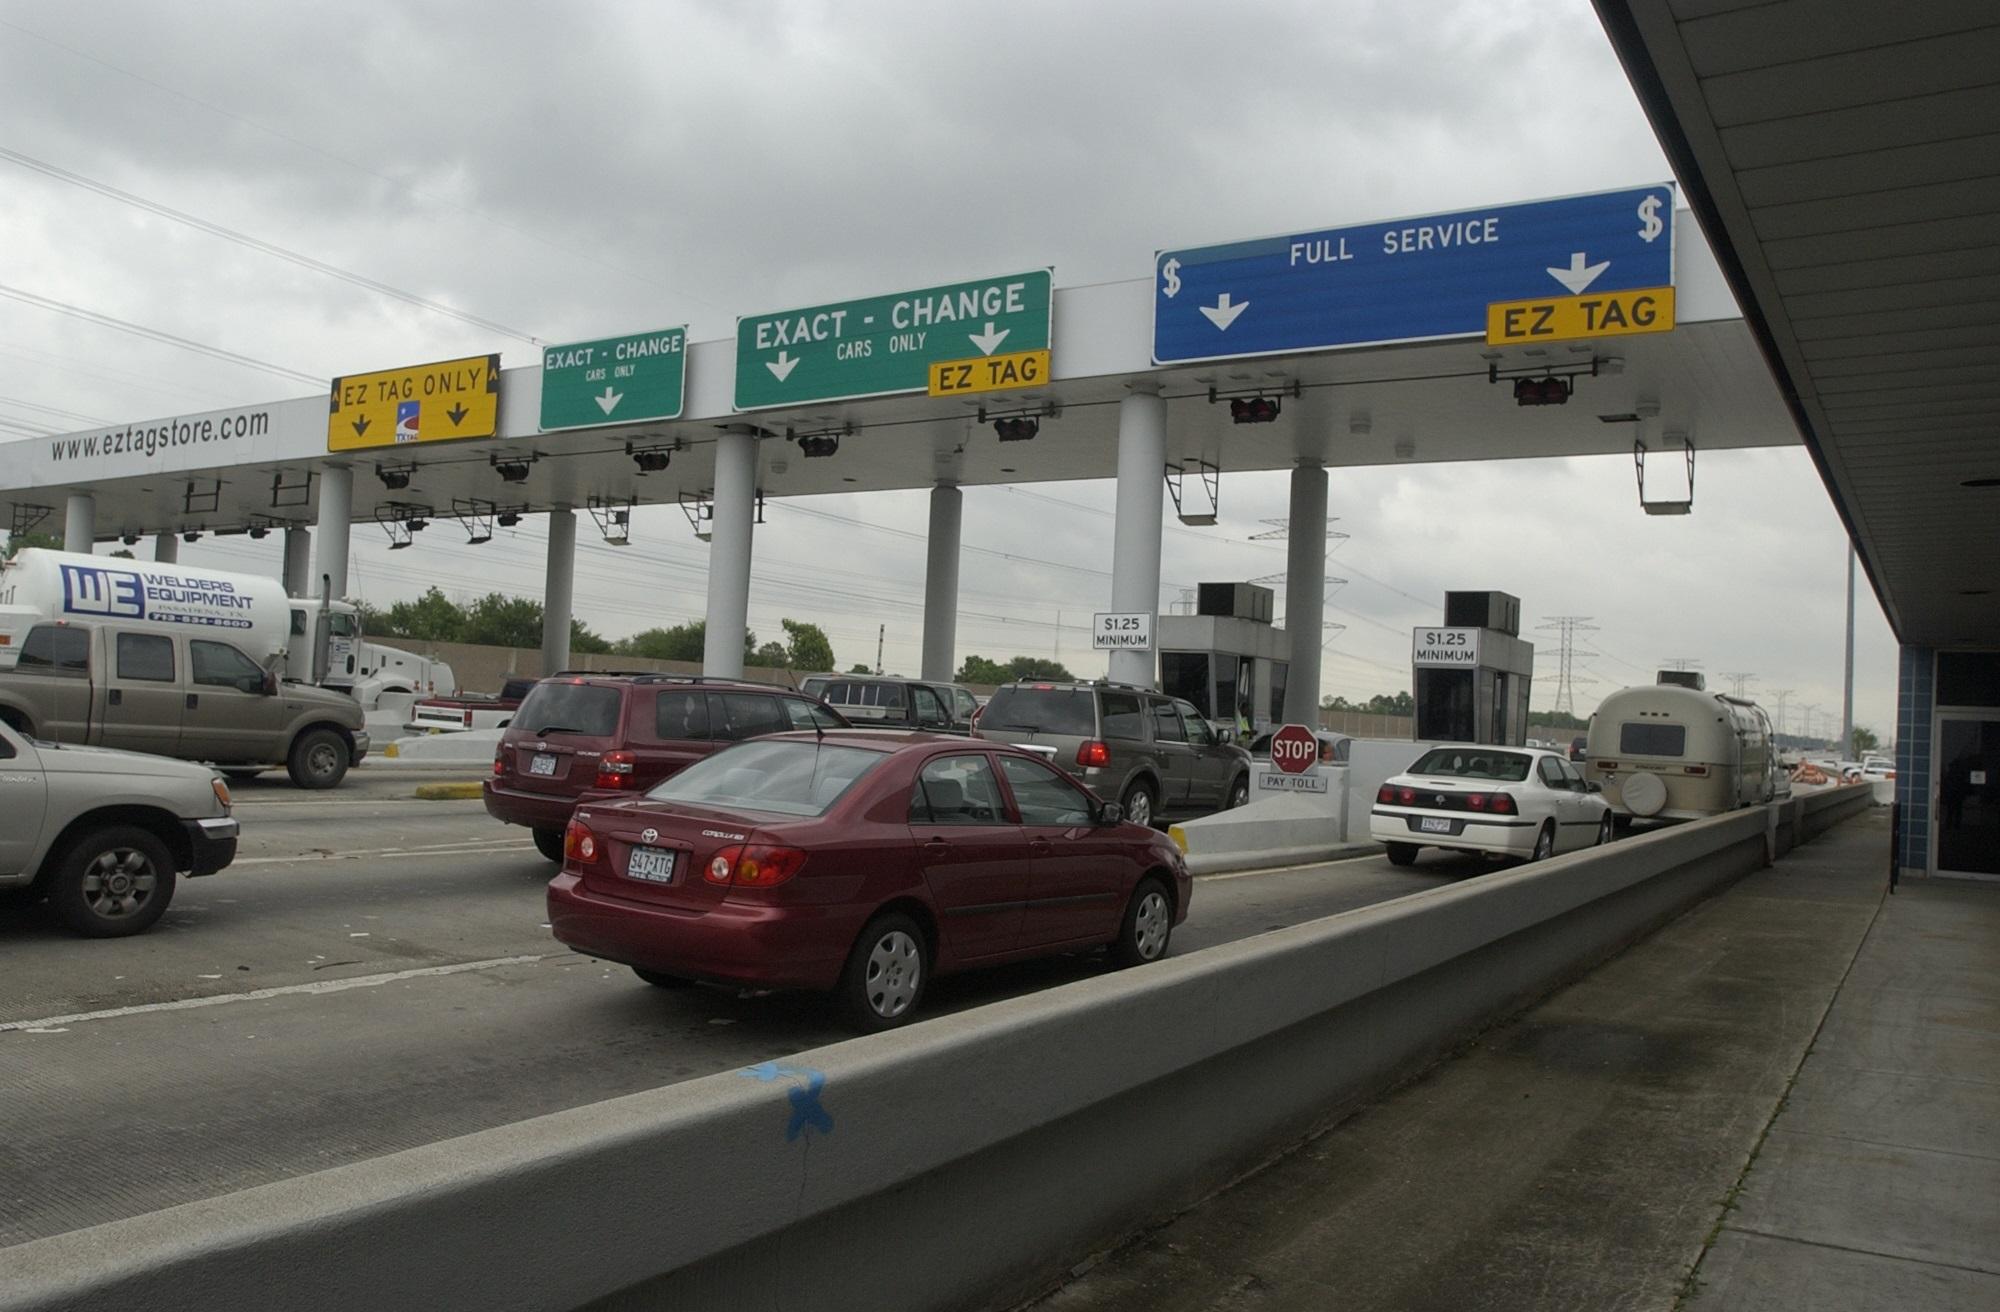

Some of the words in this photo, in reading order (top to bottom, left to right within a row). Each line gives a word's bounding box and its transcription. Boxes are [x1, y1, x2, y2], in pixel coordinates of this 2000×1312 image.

[1290, 238, 1353, 266] FULL
[1383, 218, 1499, 254] SERVICE
[756, 310, 847, 350] EXACT
[891, 282, 1025, 329] CHANGE
[1505, 305, 1555, 338] EZ
[1580, 296, 1656, 331] TAG
[545, 348, 594, 370] EXACT
[616, 335, 681, 360] CHANGE
[837, 340, 872, 360] CARS
[889, 332, 926, 353] ONLY
[585, 368, 606, 382] CARS
[614, 364, 636, 378] ONLY
[940, 364, 973, 391] EZ
[988, 357, 1037, 385] TAG
[344, 384, 368, 407] EZ
[378, 378, 413, 402] TAG
[423, 368, 481, 396] ONLY
[51, 411, 269, 461] www.eztagstore.com
[143, 573, 235, 593] WELDERS
[147, 587, 253, 609] EQUIPMENT
[1096, 634, 1147, 646] MINIMUM
[1416, 649, 1474, 661] MINIMUM
[1273, 739, 1315, 760] STOP
[1267, 776, 1285, 786] PAY
[1291, 778, 1318, 789] TOLL
